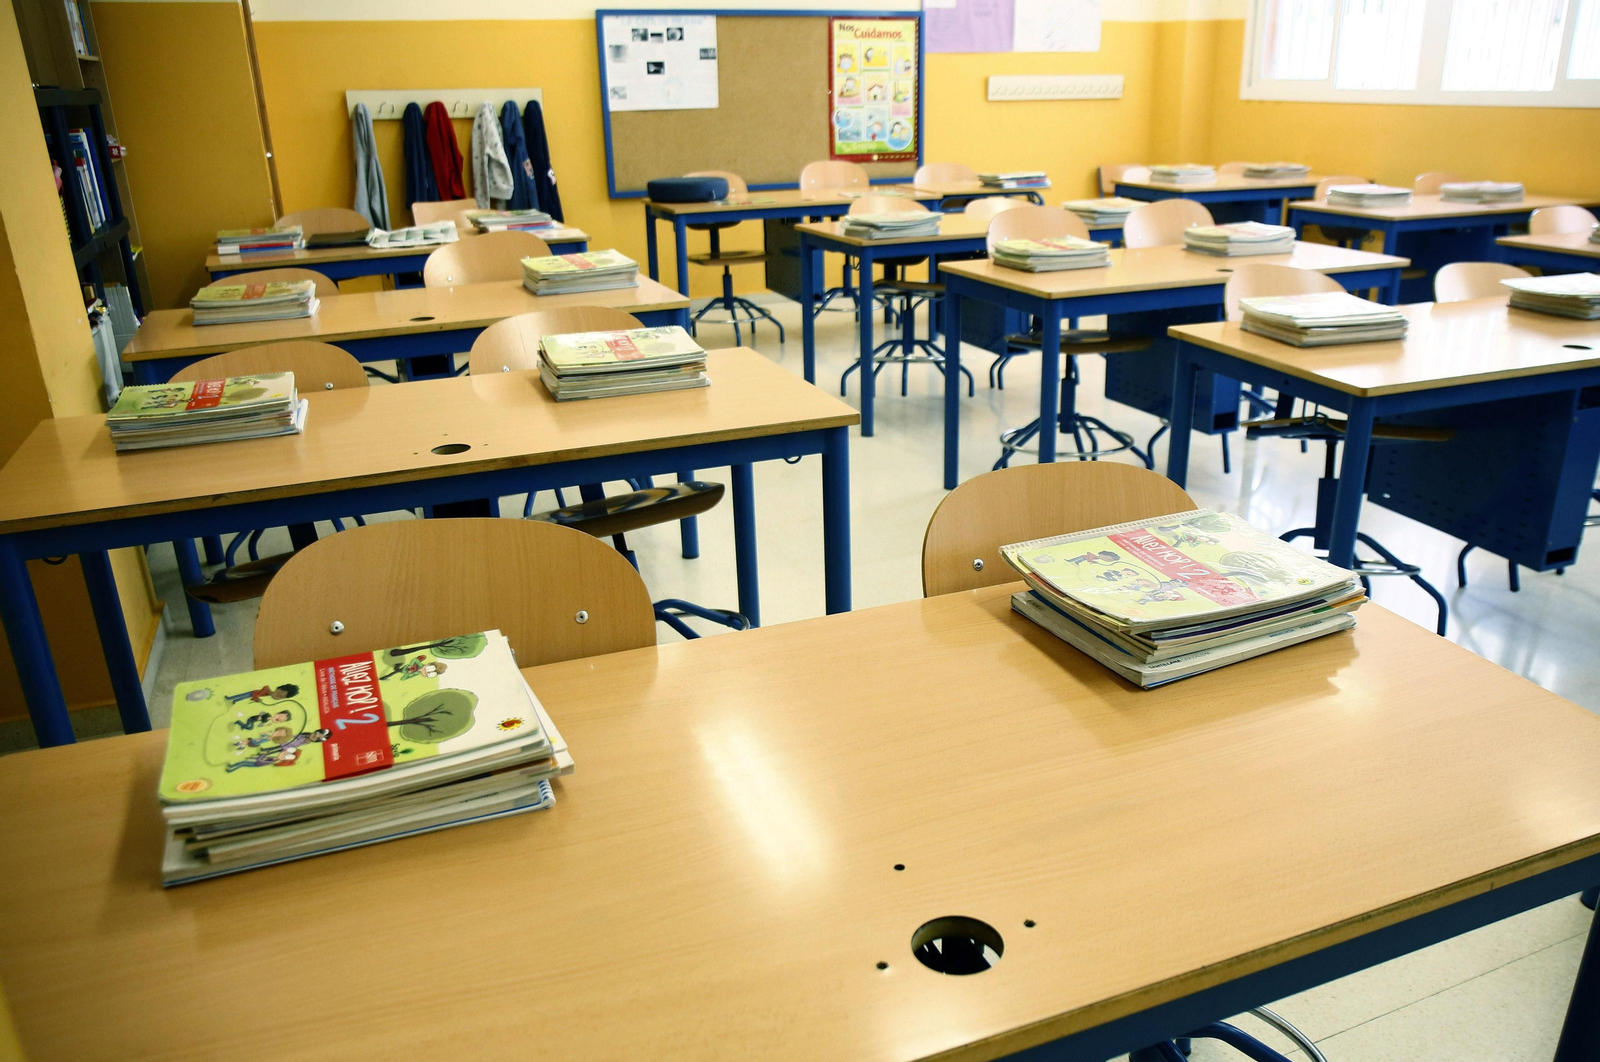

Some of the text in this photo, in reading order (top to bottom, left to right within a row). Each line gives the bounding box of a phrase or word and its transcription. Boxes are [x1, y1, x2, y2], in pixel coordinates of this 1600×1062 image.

[838, 22, 855, 32] Nos
[854, 27, 903, 39] Cuidamos
[1177, 568, 1210, 580] 2
[335, 713, 380, 730] 2
